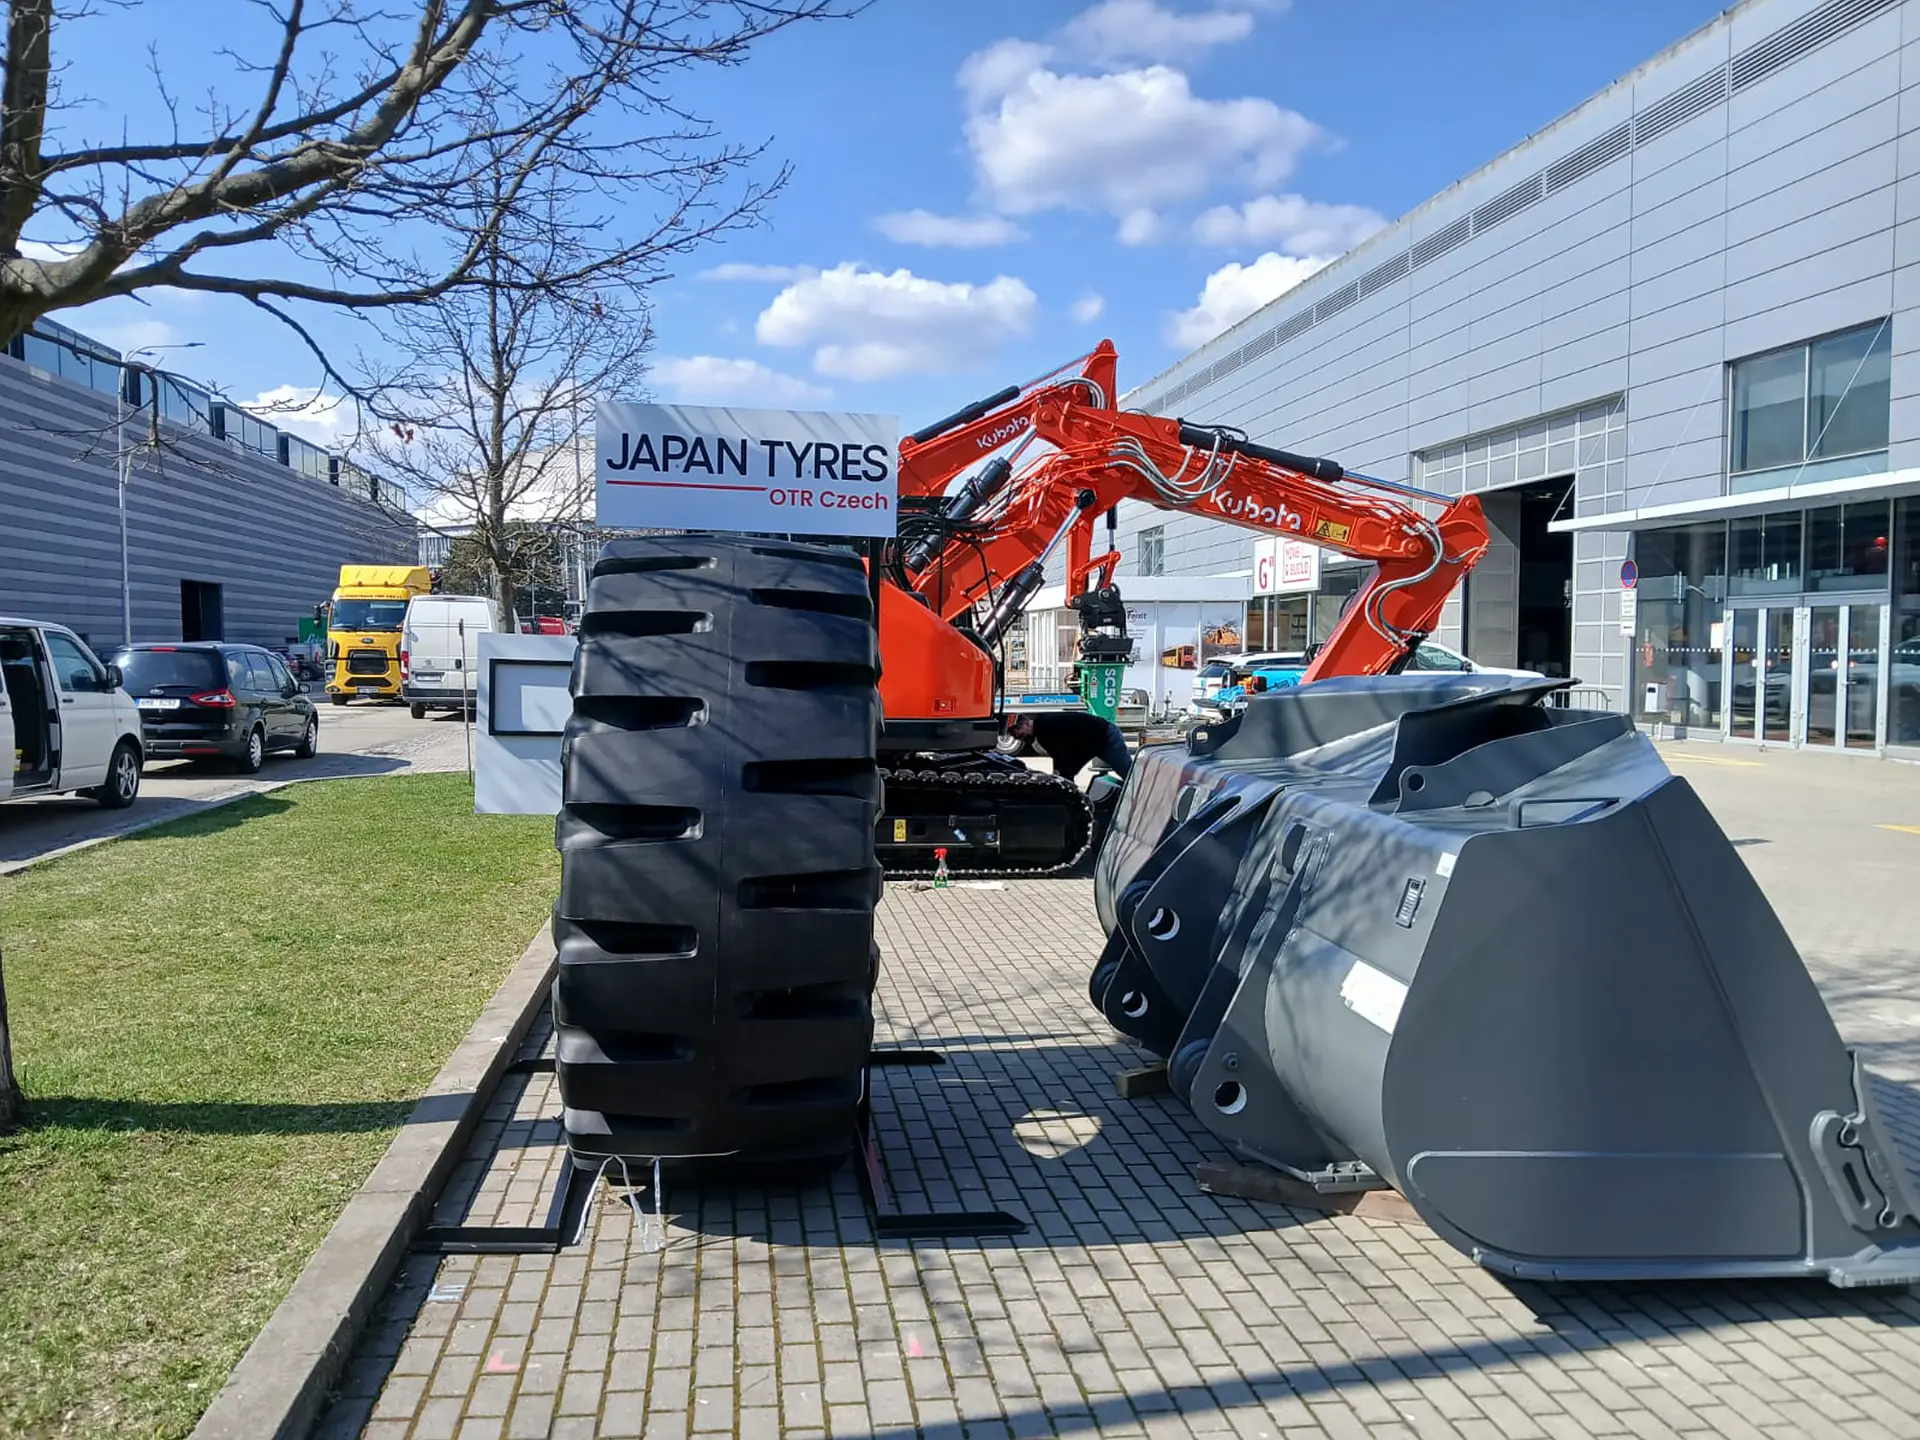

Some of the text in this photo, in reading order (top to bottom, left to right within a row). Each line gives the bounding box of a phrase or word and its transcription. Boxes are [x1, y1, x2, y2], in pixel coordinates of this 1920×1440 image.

[977, 415, 1030, 448] Kubota
[606, 433, 888, 482] JAPAN TYRES
[770, 489, 888, 510] OTR Czech
[1209, 488, 1302, 530] Kubota
[1104, 668, 1116, 708] SC50
